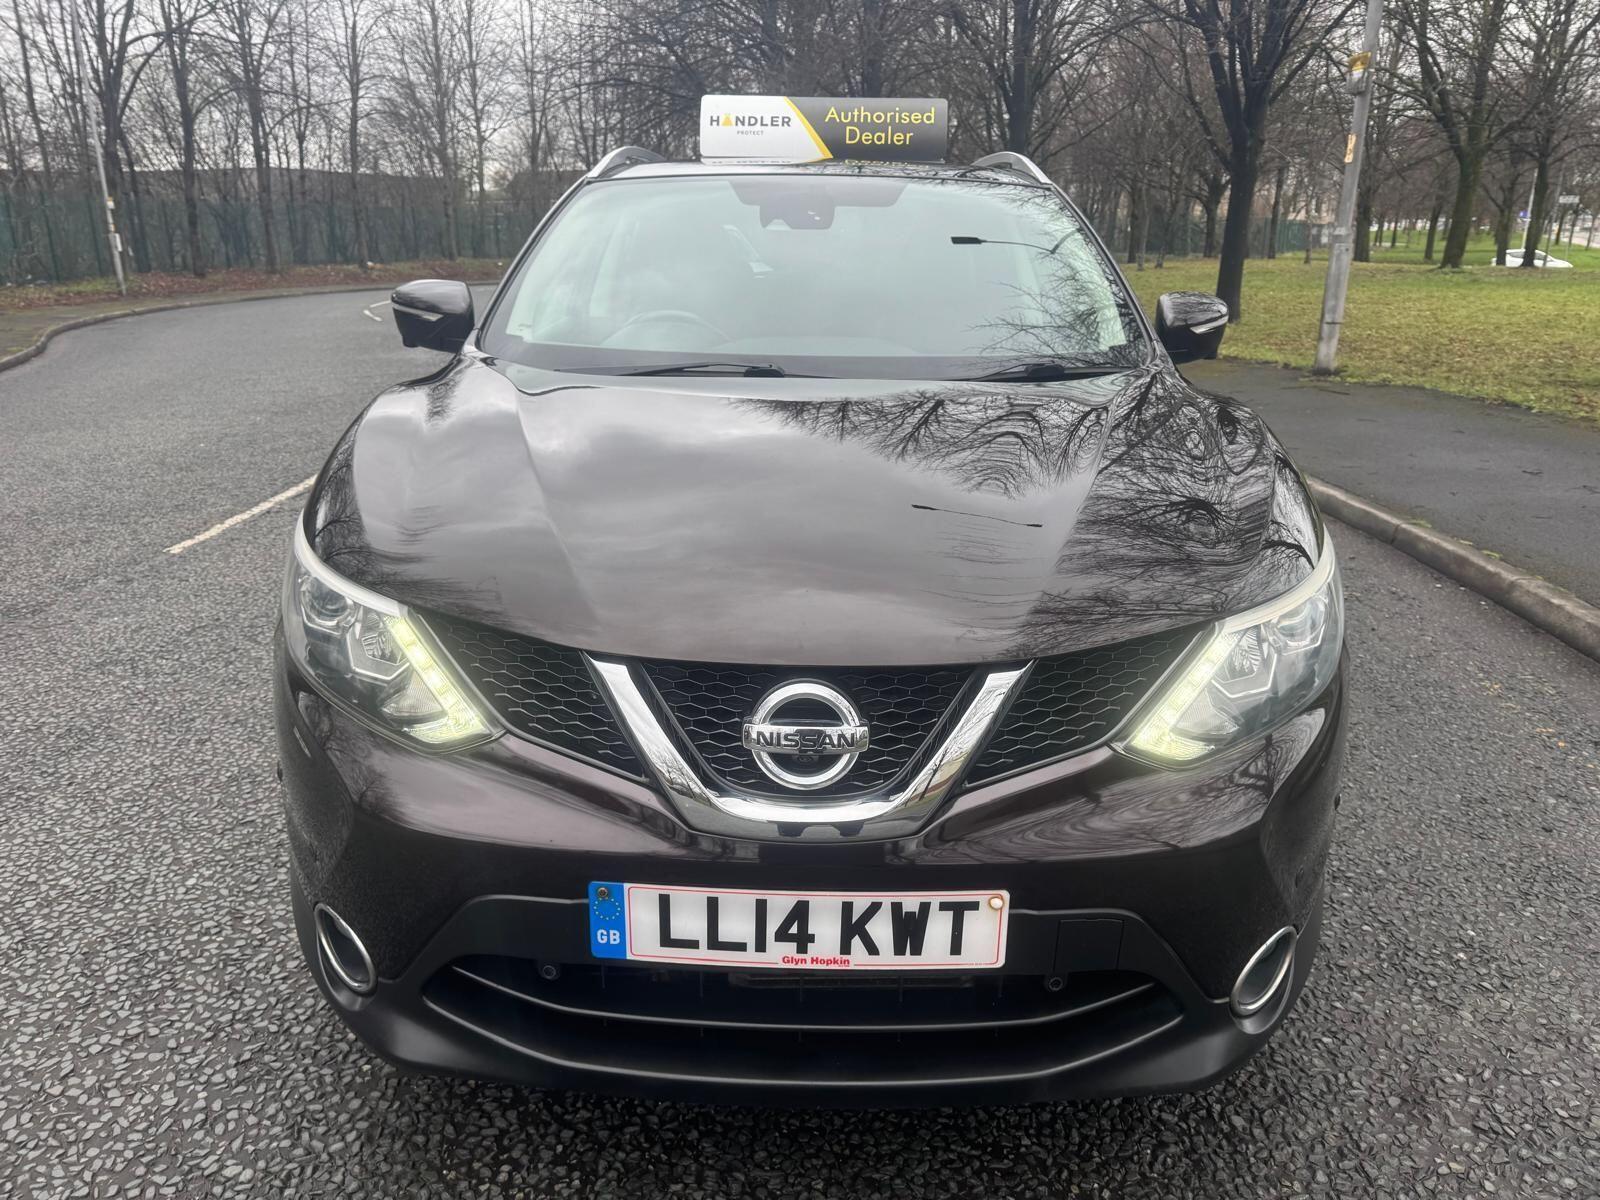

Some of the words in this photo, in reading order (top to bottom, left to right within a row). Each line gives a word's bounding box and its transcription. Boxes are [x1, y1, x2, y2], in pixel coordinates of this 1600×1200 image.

[709, 112, 792, 127] HANDLER
[824, 105, 936, 124] Authorised
[845, 125, 914, 145] Dealer
[756, 730, 856, 750] NISSAN
[658, 893, 816, 955] LL14
[839, 900, 980, 957] KWT
[596, 928, 621, 946] GB
[781, 955, 807, 966] Glyn
[810, 956, 850, 967] Hopkin
